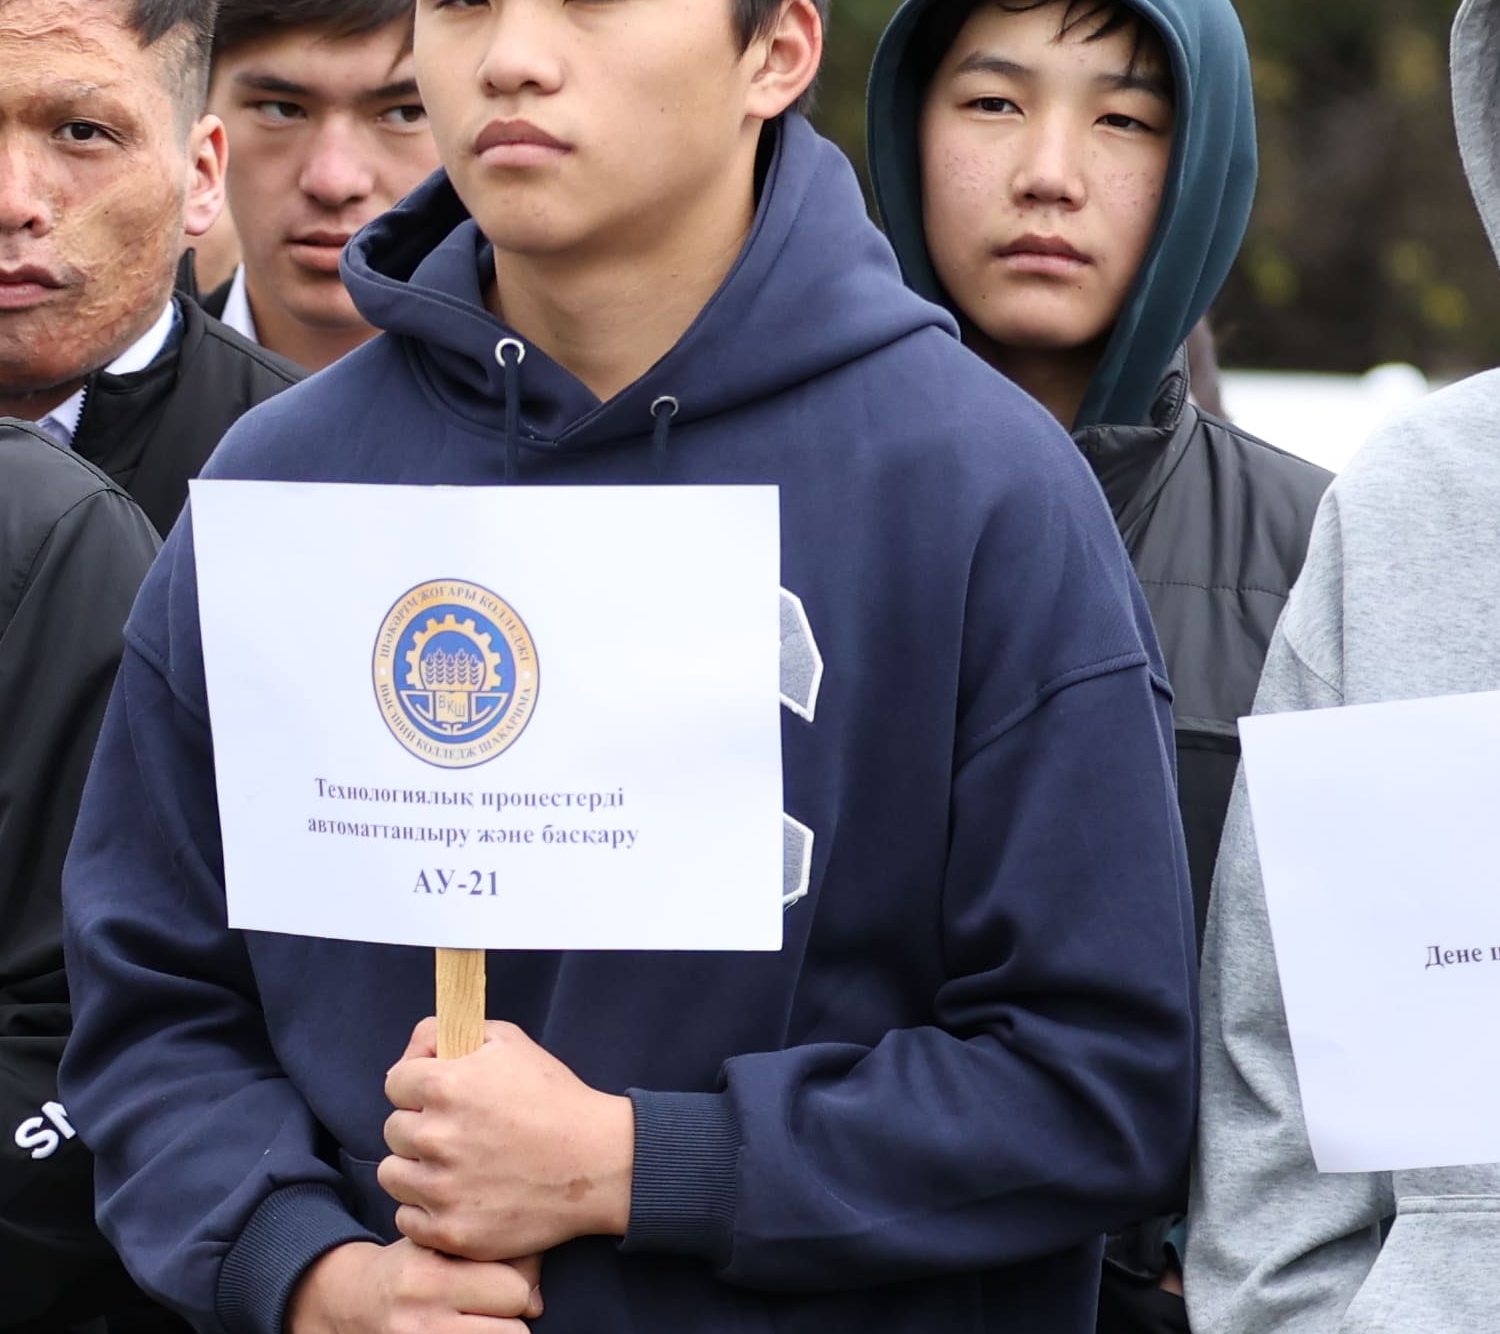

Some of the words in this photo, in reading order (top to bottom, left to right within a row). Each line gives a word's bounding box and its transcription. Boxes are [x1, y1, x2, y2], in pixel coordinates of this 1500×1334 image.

[314, 777, 474, 807] Технологиялық
[481, 787, 625, 813] процестерді
[307, 818, 469, 848] автоматтандыру
[477, 828, 534, 844] және
[541, 824, 640, 849] басқару
[412, 868, 499, 896] АУ-21
[1425, 945, 1483, 971] Дене
